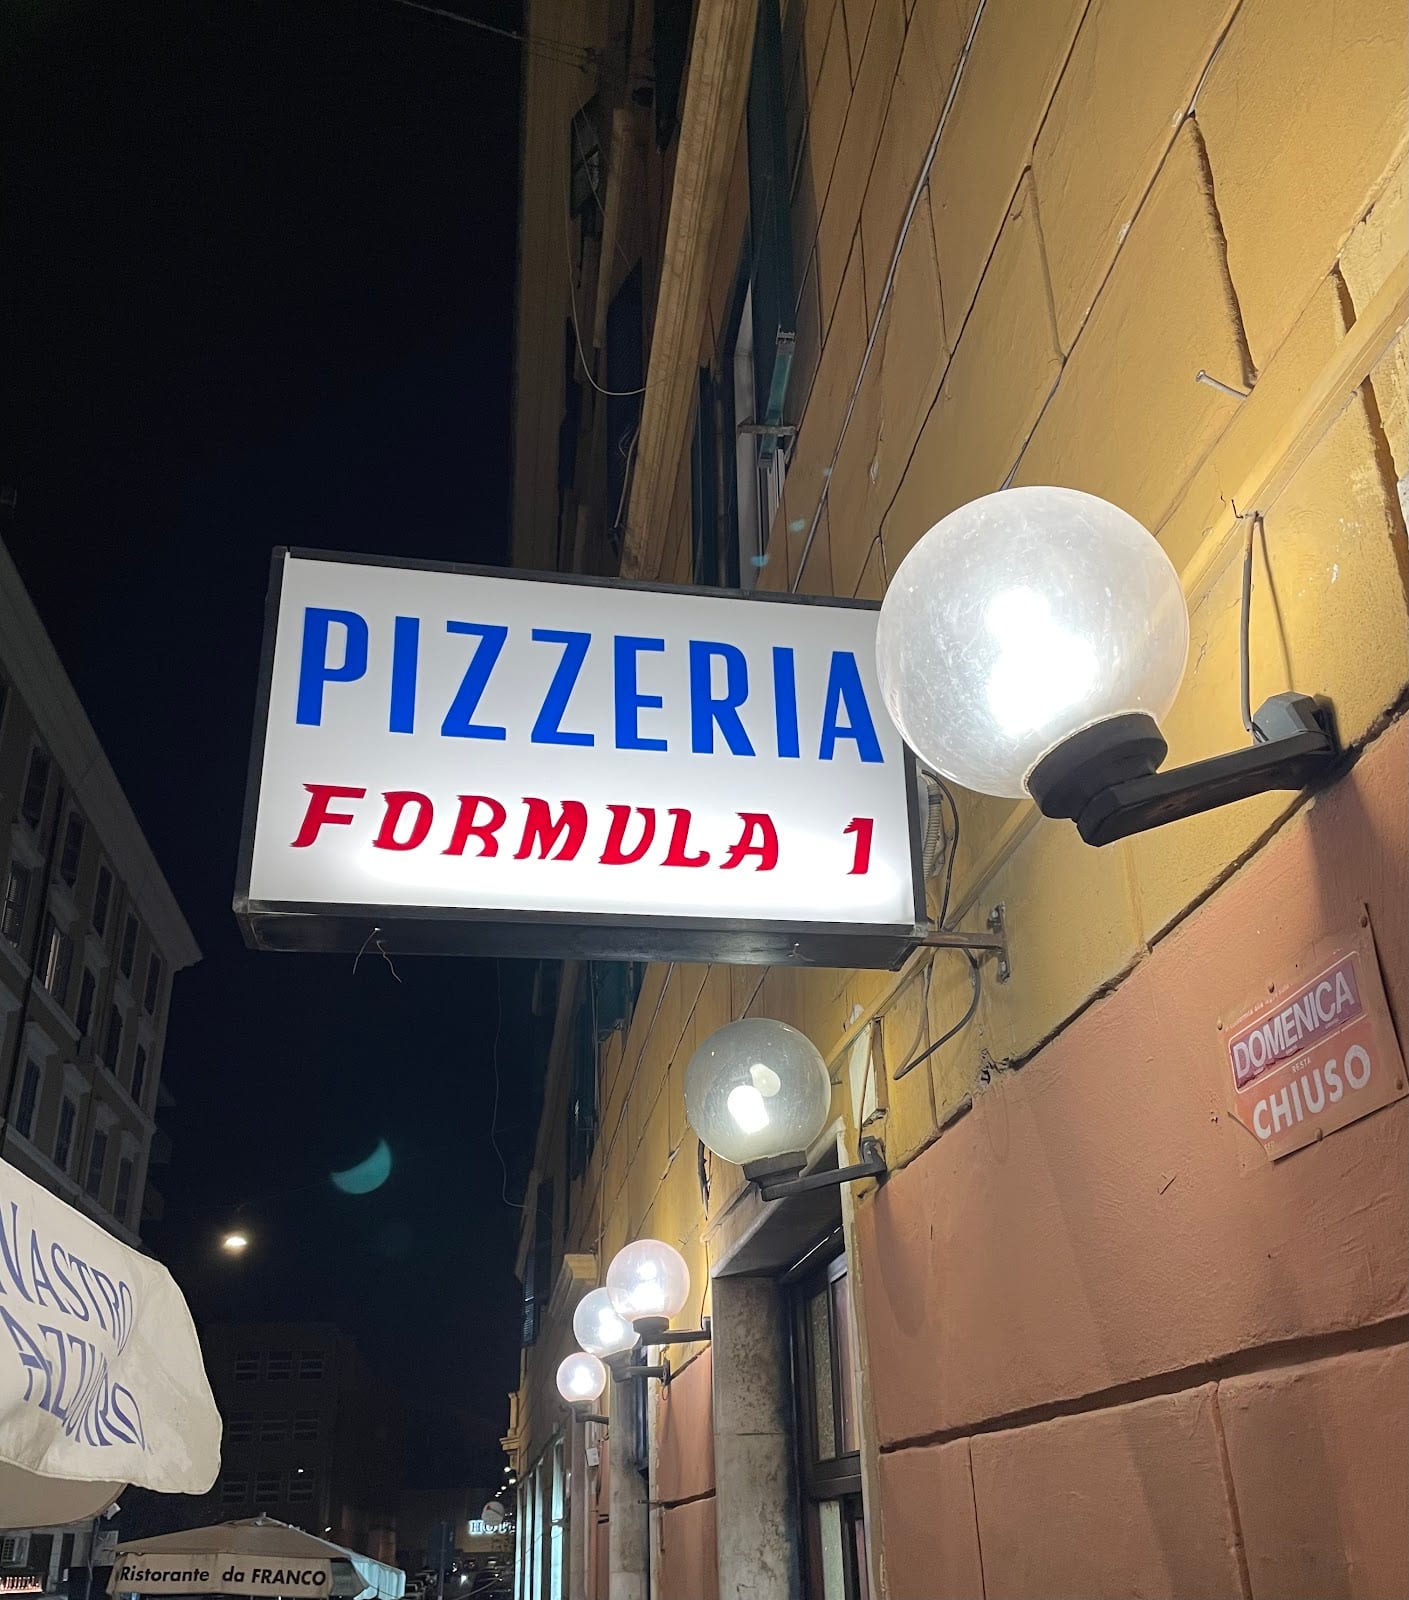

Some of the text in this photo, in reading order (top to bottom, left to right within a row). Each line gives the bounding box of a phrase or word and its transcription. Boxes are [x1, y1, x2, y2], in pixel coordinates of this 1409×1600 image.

[295, 606, 885, 764] PIZZERIA
[290, 783, 875, 876] FORMULA 1
[1232, 970, 1356, 1081] DOMENICA
[1291, 1056, 1312, 1074] RESTA
[1252, 1044, 1371, 1140] CHIUSO
[0, 1201, 133, 1357] NASTRO
[120, 1565, 327, 1586] Ristorante da FRANCO
